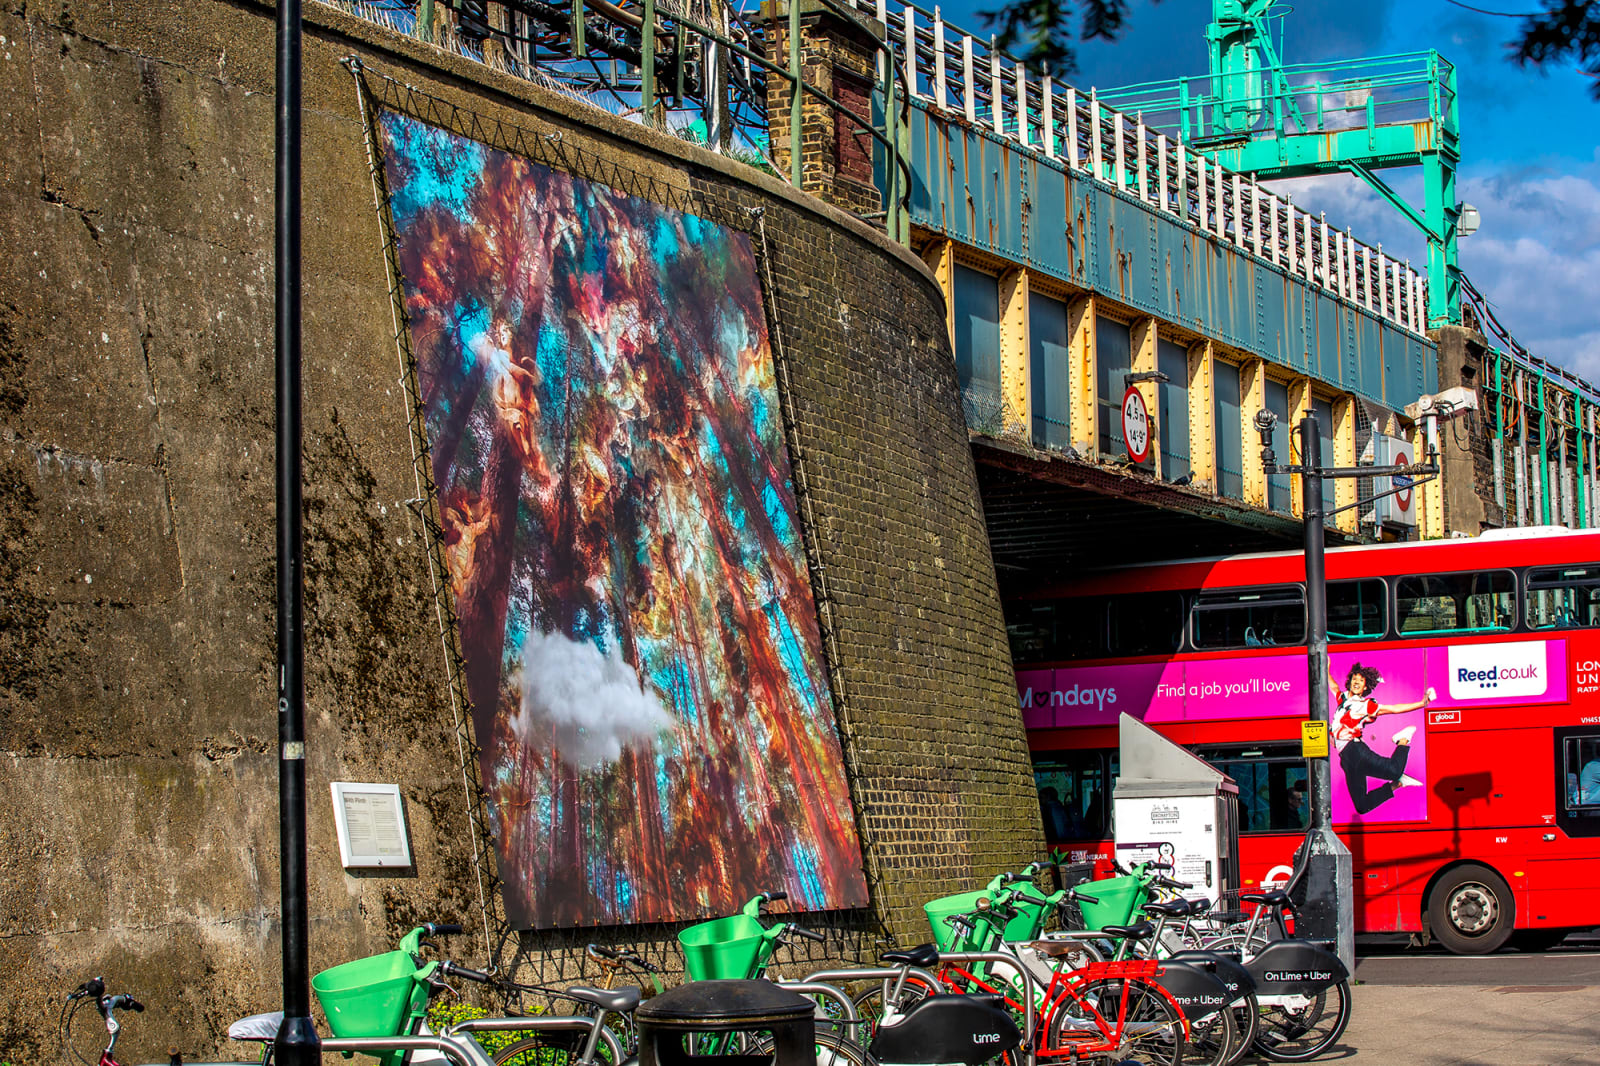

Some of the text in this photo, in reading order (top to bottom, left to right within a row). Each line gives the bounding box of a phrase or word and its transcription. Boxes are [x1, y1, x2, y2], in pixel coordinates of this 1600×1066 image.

[1457, 664, 1537, 682] Reed.co.uk
[1157, 678, 1291, 699] Find a job you'll love
[1435, 713, 1454, 723] global
[1265, 971, 1280, 981] On
[1281, 972, 1302, 981] Lime
[1311, 971, 1332, 980] Uber
[1200, 995, 1224, 1005] Uber
[973, 1033, 1001, 1044] Lime
